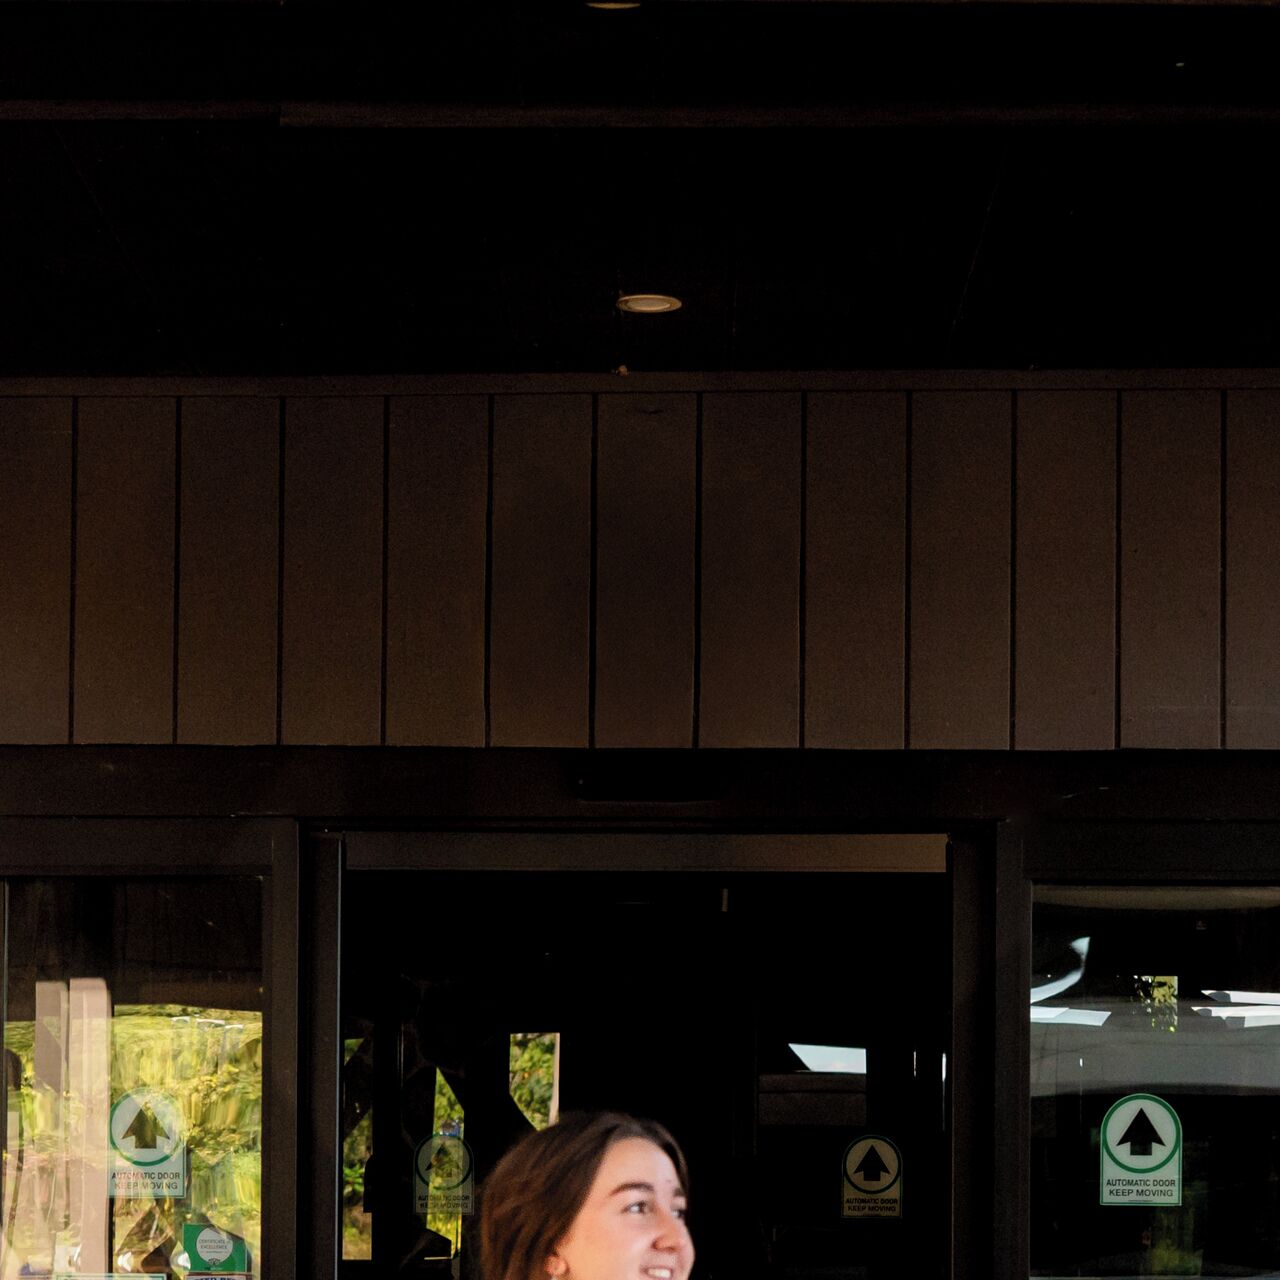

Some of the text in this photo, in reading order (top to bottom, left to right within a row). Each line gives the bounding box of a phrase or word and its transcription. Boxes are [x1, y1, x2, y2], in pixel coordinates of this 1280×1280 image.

[111, 1172, 180, 1180] AUTOMATIC DOOR
[114, 1182, 178, 1190] KEEP MOVING
[1106, 1179, 1176, 1187] AUTOMATIC DOOR
[1108, 1189, 1174, 1197] KEEP MOVING
